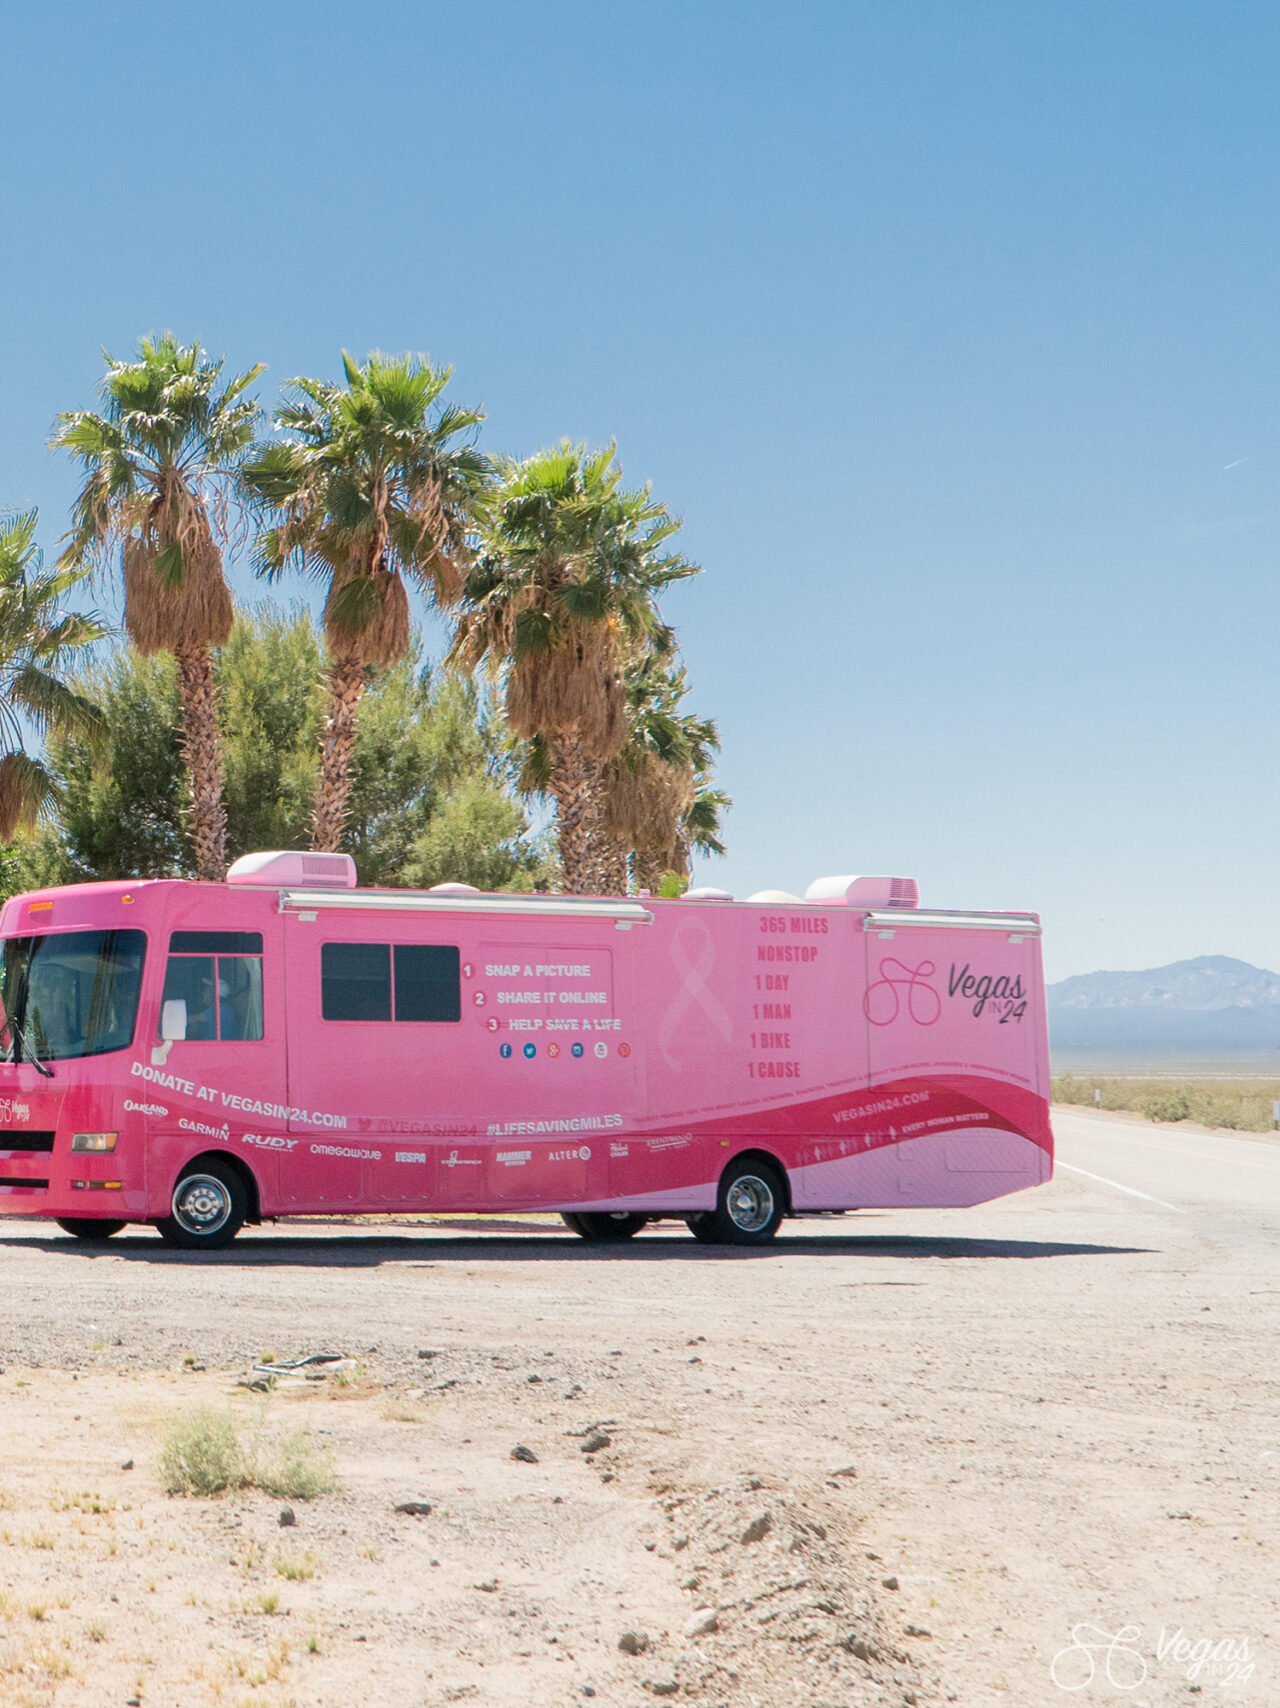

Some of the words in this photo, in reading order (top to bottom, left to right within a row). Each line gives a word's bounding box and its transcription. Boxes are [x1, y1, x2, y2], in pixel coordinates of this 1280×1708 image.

[760, 916, 786, 933] 365
[791, 917, 829, 934] MILES
[757, 945, 818, 962] NONSTOP
[485, 965, 520, 977] SNAP
[523, 965, 534, 977] A
[536, 965, 591, 977] PICTURE
[754, 975, 761, 990] 1
[765, 975, 790, 990] DAY
[948, 962, 1027, 1018] Vegas
[497, 992, 541, 1004] SHARE
[544, 992, 556, 1004] IT
[559, 992, 607, 1004] ONLINE
[752, 1004, 759, 1020] 1
[763, 1004, 792, 1020] MAN
[988, 1001, 1002, 1013] IN
[999, 1000, 1027, 1024] 24
[509, 1019, 543, 1031] HELP
[546, 1019, 579, 1031] SAVE
[582, 1019, 592, 1031] A
[594, 1019, 622, 1031] LIFE
[750, 1033, 757, 1049] 1
[760, 1033, 791, 1049] BIKE
[748, 1062, 755, 1079] 1
[758, 1062, 800, 1078] CAUSE
[131, 1062, 194, 1096] DONATE
[197, 1086, 218, 1102] AT
[222, 1093, 348, 1129] VEGASIN24.COM
[486, 1113, 623, 1136] #LIFESAVINGMILES
[832, 1090, 930, 1122] VEGASIN24.COM
[179, 1118, 230, 1141] GARMIN
[902, 1121, 926, 1133] EVERY
[927, 1116, 955, 1127] WOMAN
[956, 1113, 989, 1122] MATTERS
[241, 1132, 299, 1149] RUDY
